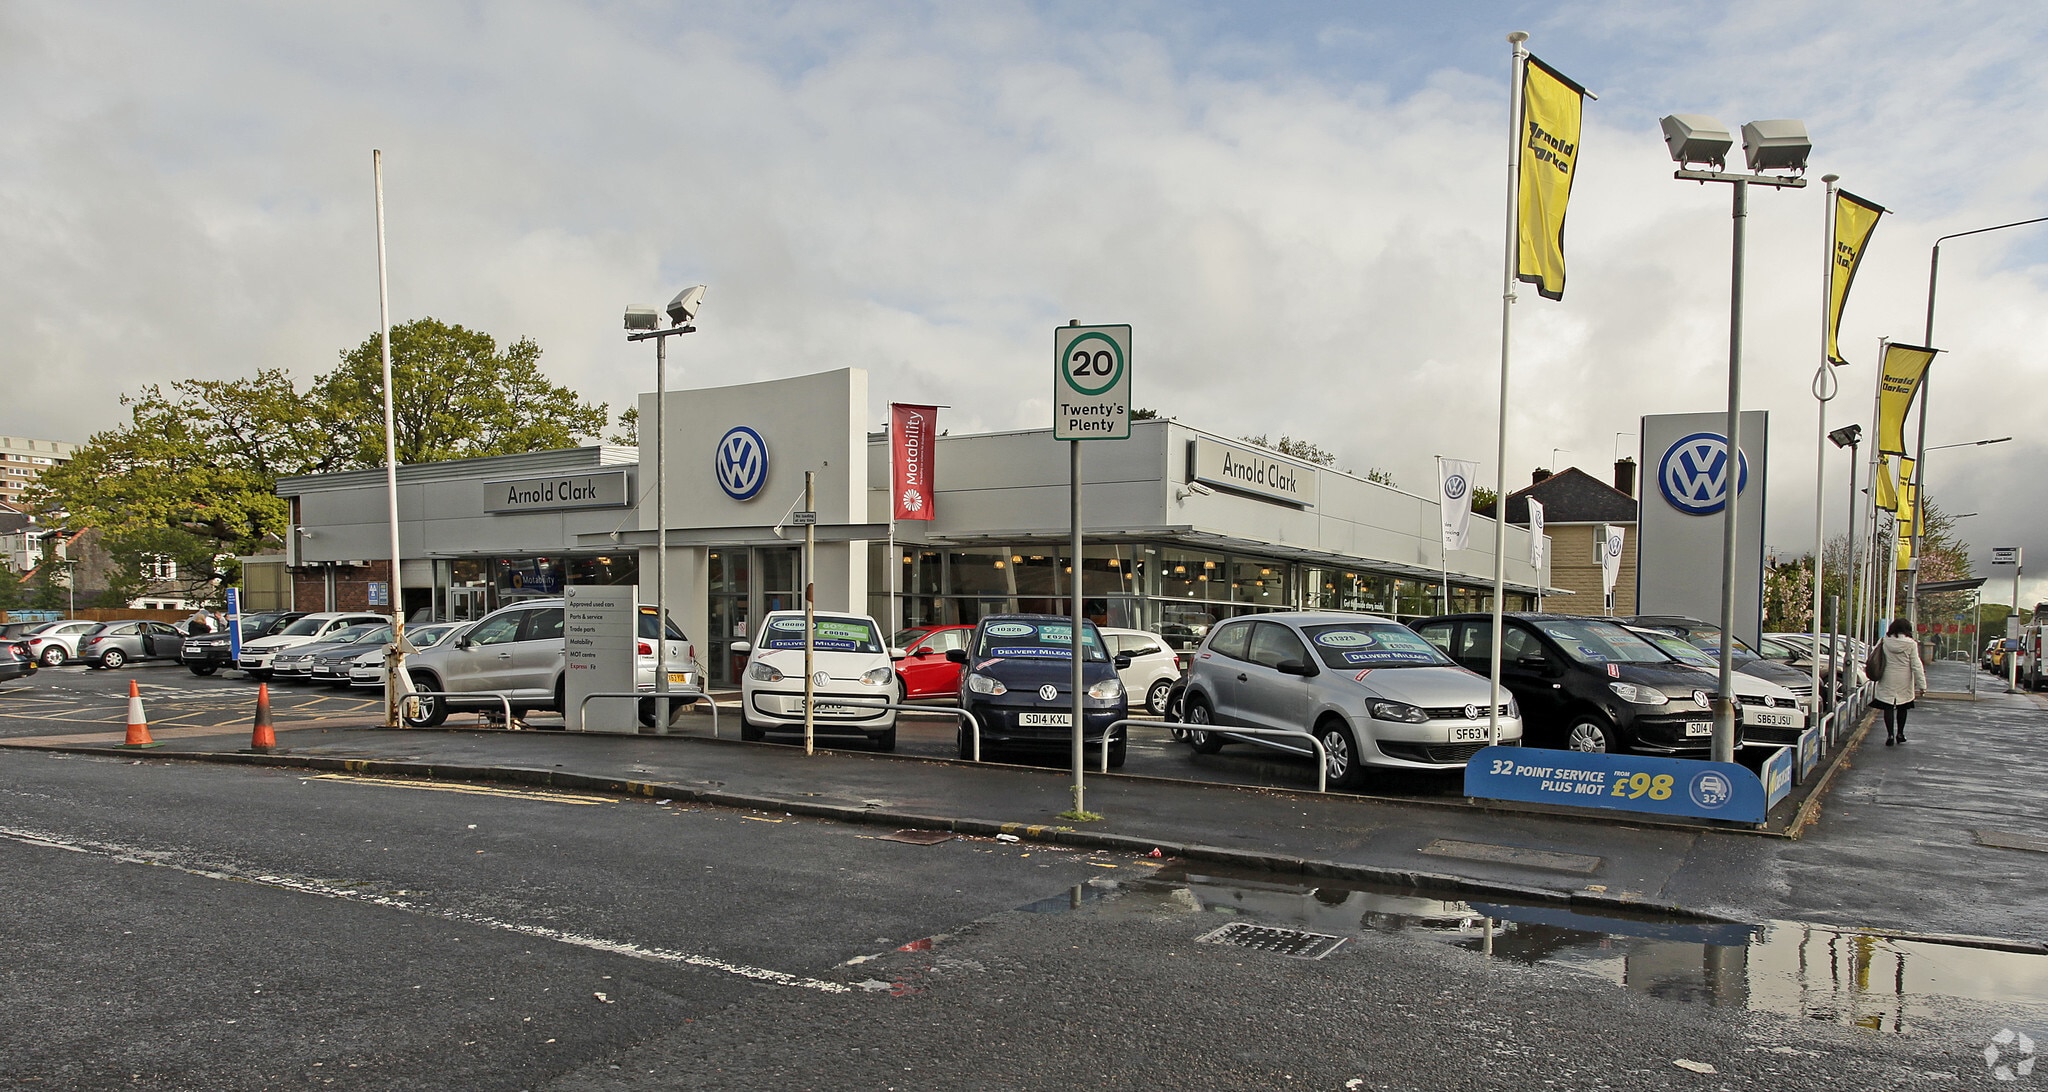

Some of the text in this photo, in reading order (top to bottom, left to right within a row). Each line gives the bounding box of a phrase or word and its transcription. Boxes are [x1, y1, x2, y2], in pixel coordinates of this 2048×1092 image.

[1072, 350, 1113, 376] 20
[1061, 403, 1124, 417] Twenty's
[1070, 419, 1115, 432] Plenty
[905, 411, 923, 485] Motability
[1223, 452, 1296, 492] Arnold Clark
[508, 479, 596, 504] Arnold Clark
[570, 601, 592, 609] Approved
[1351, 653, 1391, 661] DELIVERY
[1026, 714, 1068, 724] SD14 KXL
[1758, 714, 1791, 725] SB63 JSU
[1456, 728, 1481, 740] SF63
[1692, 723, 1708, 734] SD14
[1490, 760, 1605, 783] 32 POINT SERVICE
[1540, 780, 1605, 796] PLUS MOT
[1611, 772, 1674, 800] £98
[1702, 794, 1717, 804] 32
